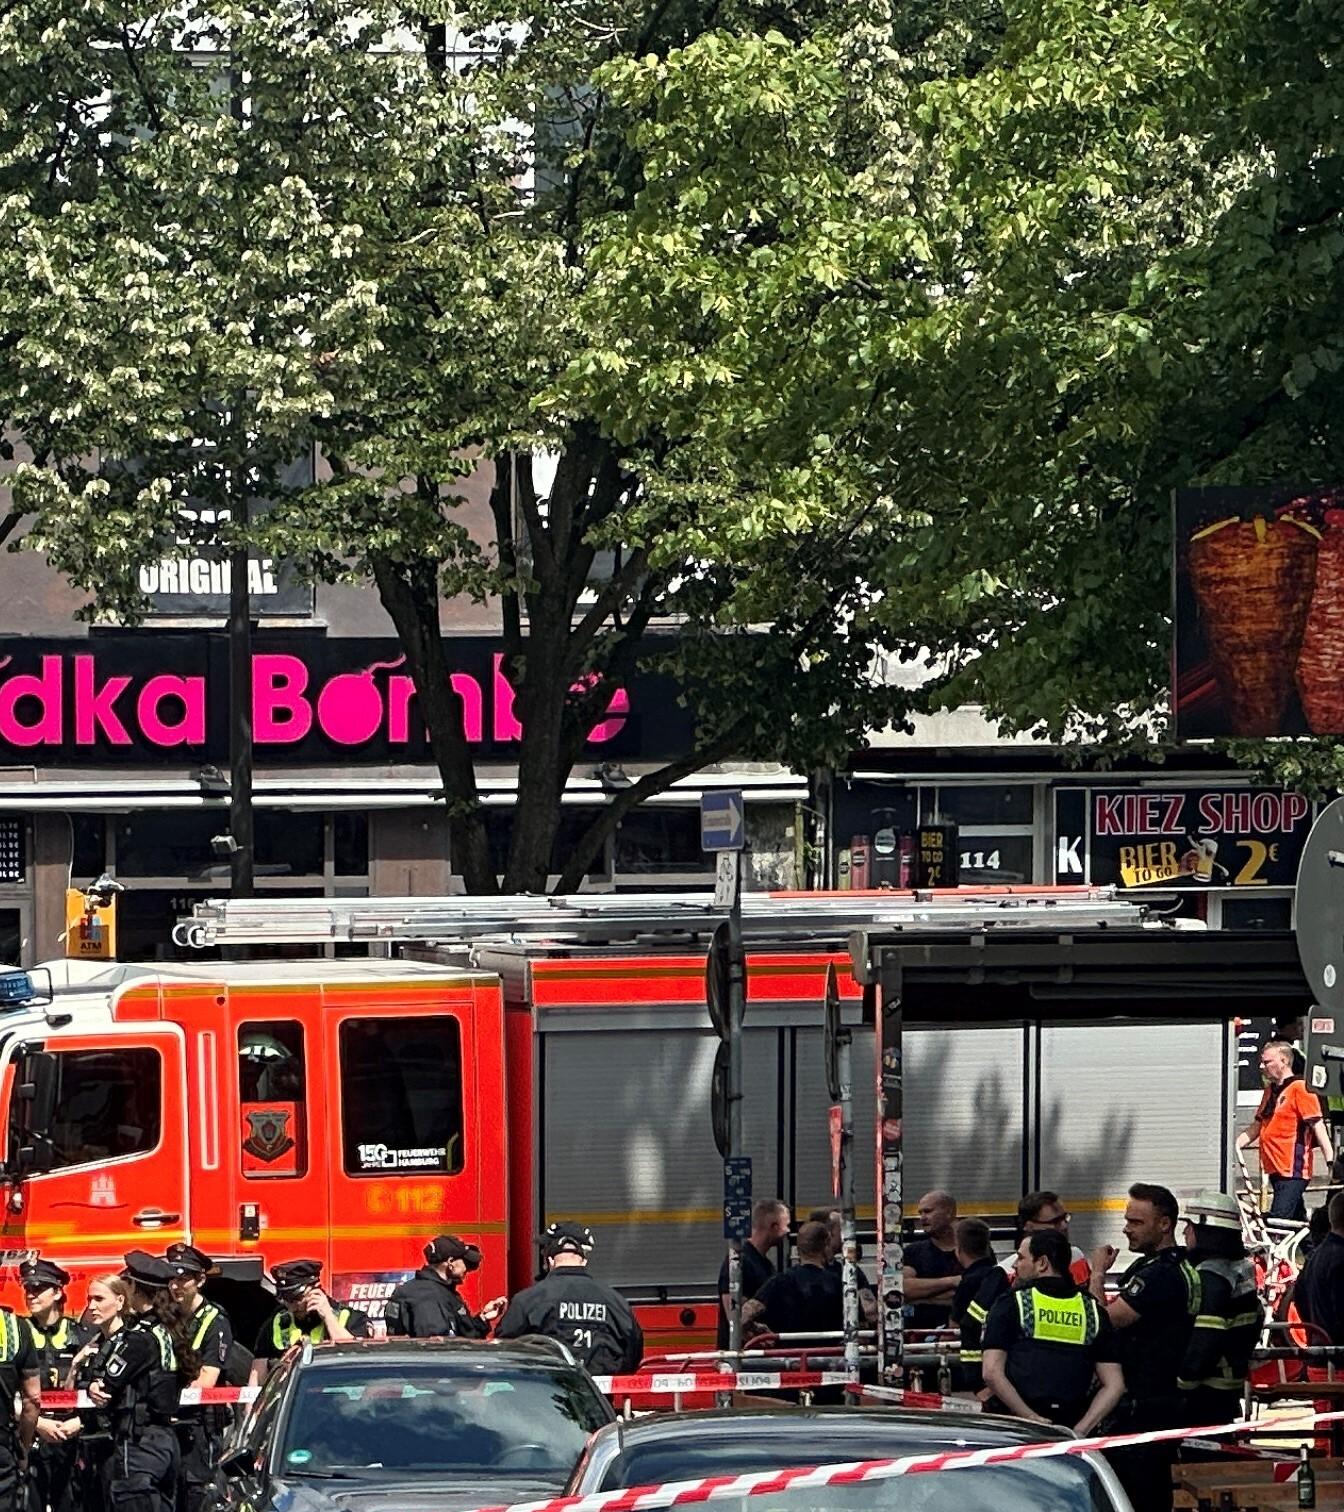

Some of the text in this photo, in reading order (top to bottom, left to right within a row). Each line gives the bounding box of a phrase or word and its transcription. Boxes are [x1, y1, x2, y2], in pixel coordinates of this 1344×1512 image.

[1095, 792, 1308, 836] KIEZ SHOP
[920, 831, 944, 849] BIER
[921, 851, 944, 863] TO GO
[960, 850, 1001, 870] 114
[1058, 836, 1083, 874] K
[1120, 841, 1178, 870] BIER
[1135, 866, 1173, 883] TO GO
[80, 942, 102, 950] ATM
[398, 1158, 440, 1167] HAMBURG
[396, 1184, 444, 1212] 112
[559, 1302, 607, 1322] POLIZEI
[1038, 1308, 1083, 1327] POLIZEI
[572, 1328, 593, 1349] 21
